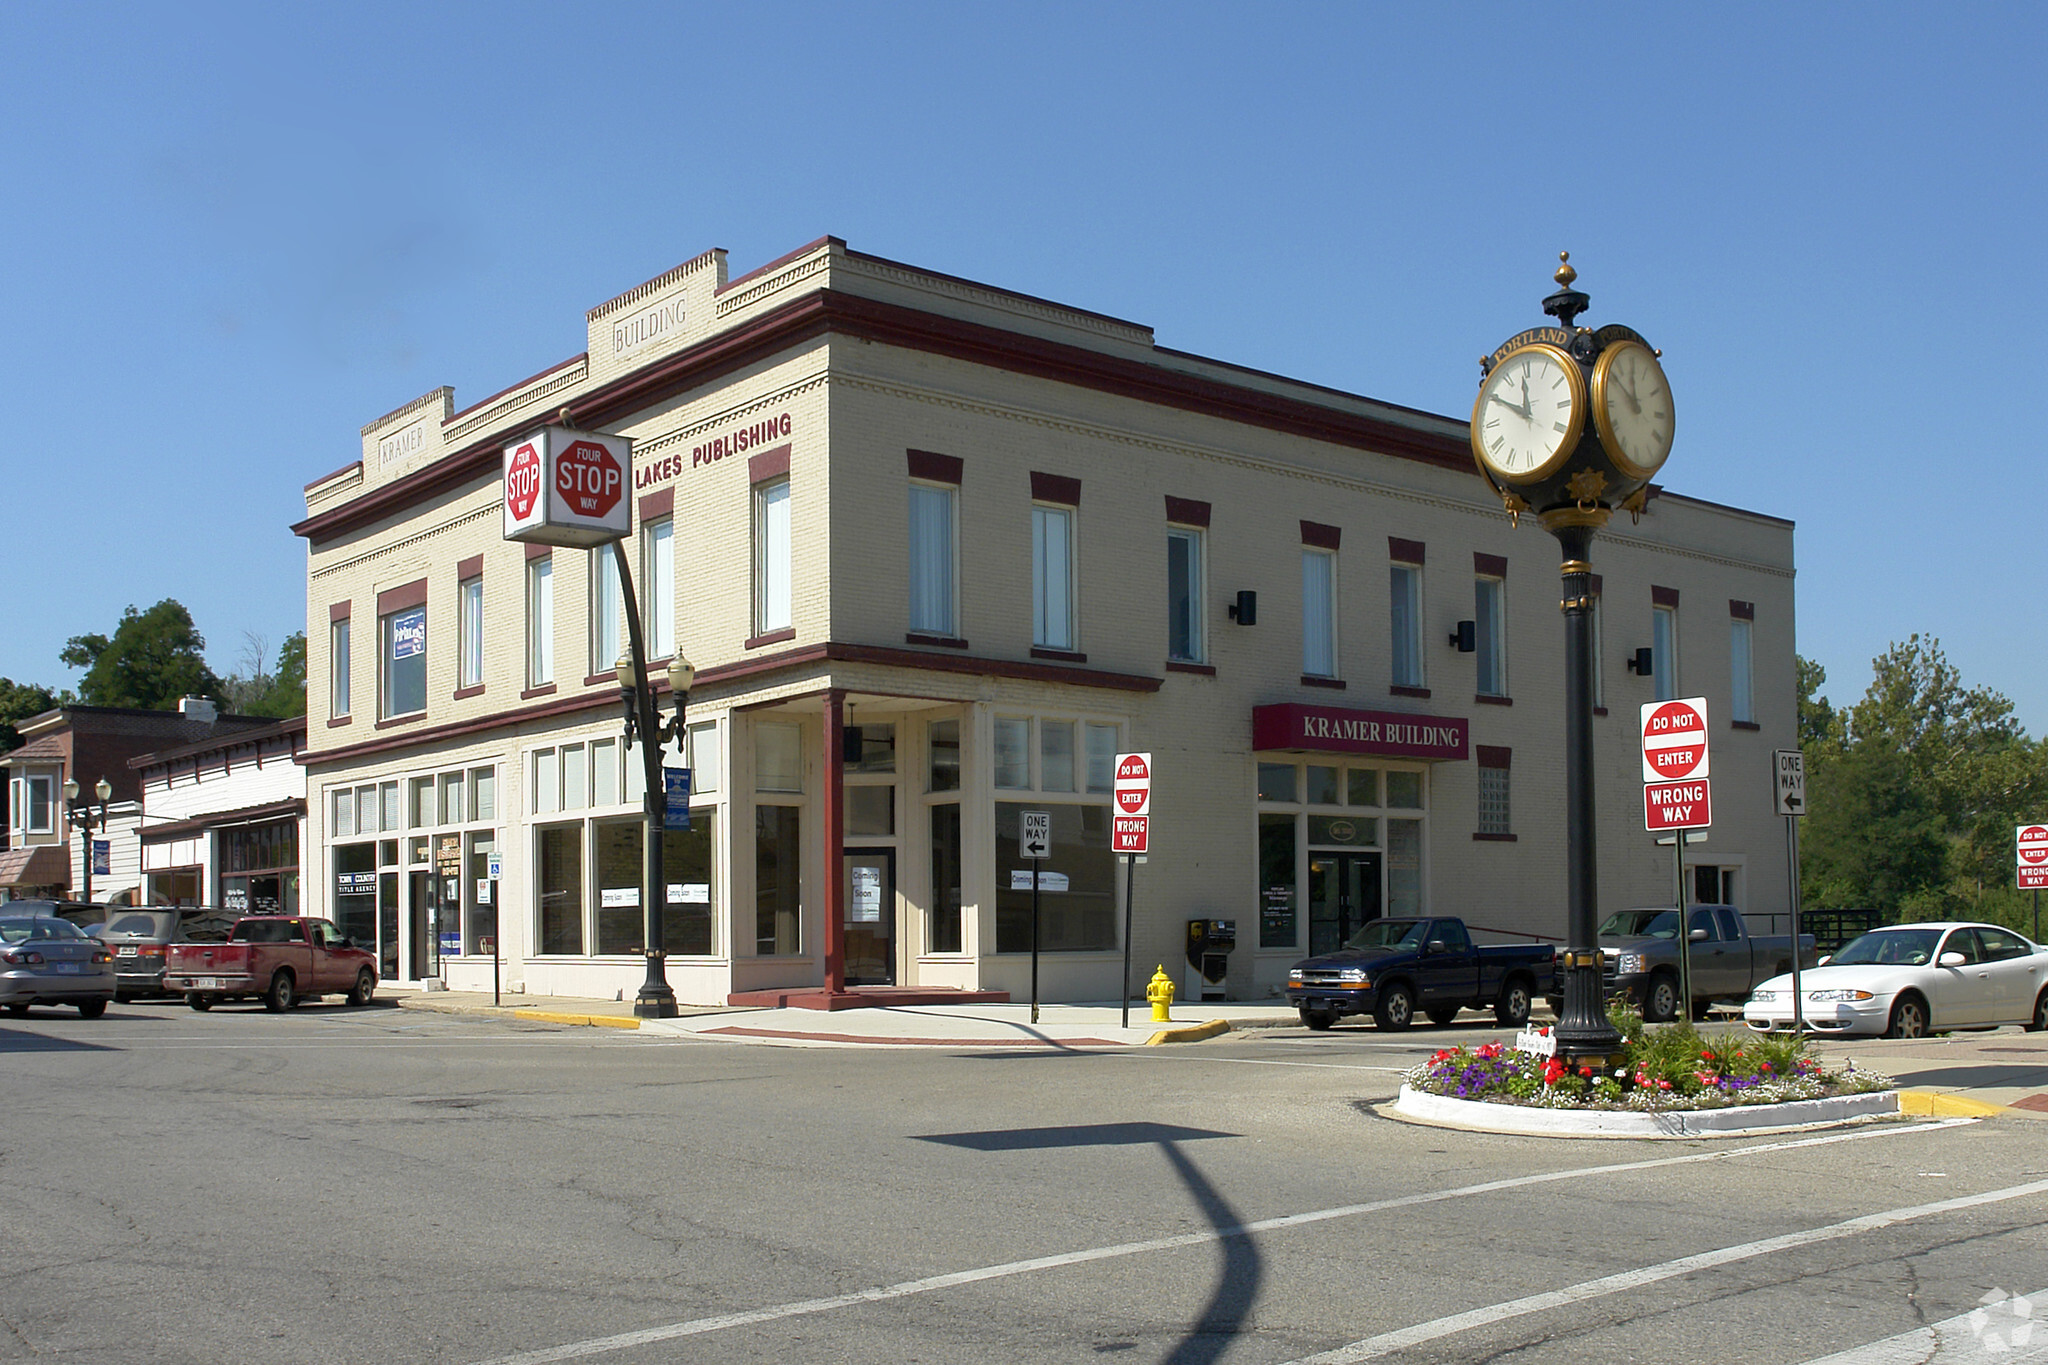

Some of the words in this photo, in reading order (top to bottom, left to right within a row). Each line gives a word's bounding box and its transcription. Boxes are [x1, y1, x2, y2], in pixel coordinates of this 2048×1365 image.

[616, 299, 686, 352] BUILDING
[1494, 328, 1568, 361] PORTLAND
[382, 427, 423, 464] KRAMER
[636, 455, 682, 489] LAKES
[693, 413, 791, 468] PUBLISHING
[517, 451, 530, 466] FOUR
[577, 448, 601, 462] FOUR
[509, 463, 538, 501] STOP
[559, 462, 619, 496] STOP
[580, 497, 598, 510] WAY
[1653, 717, 1668, 730] DO
[1672, 713, 1694, 728] NOT
[1304, 716, 1380, 742] KRAMER
[1385, 724, 1460, 747] BUILDING
[1657, 751, 1693, 766] ENTER
[1781, 756, 1801, 772] ONE
[1121, 765, 1131, 775] DO
[1132, 765, 1144, 775] NOT
[1781, 774, 1802, 789] WAY
[1122, 794, 1142, 803] ENTER
[1651, 786, 1703, 805] WRONG
[1027, 816, 1047, 827] ONE
[1662, 806, 1692, 822] WAY
[1026, 829, 1047, 839] WAY
[1117, 821, 1145, 832] WRONG
[1122, 835, 1139, 846] WAY
[852, 872, 878, 881] Coming
[2027, 877, 2044, 885] WAY
